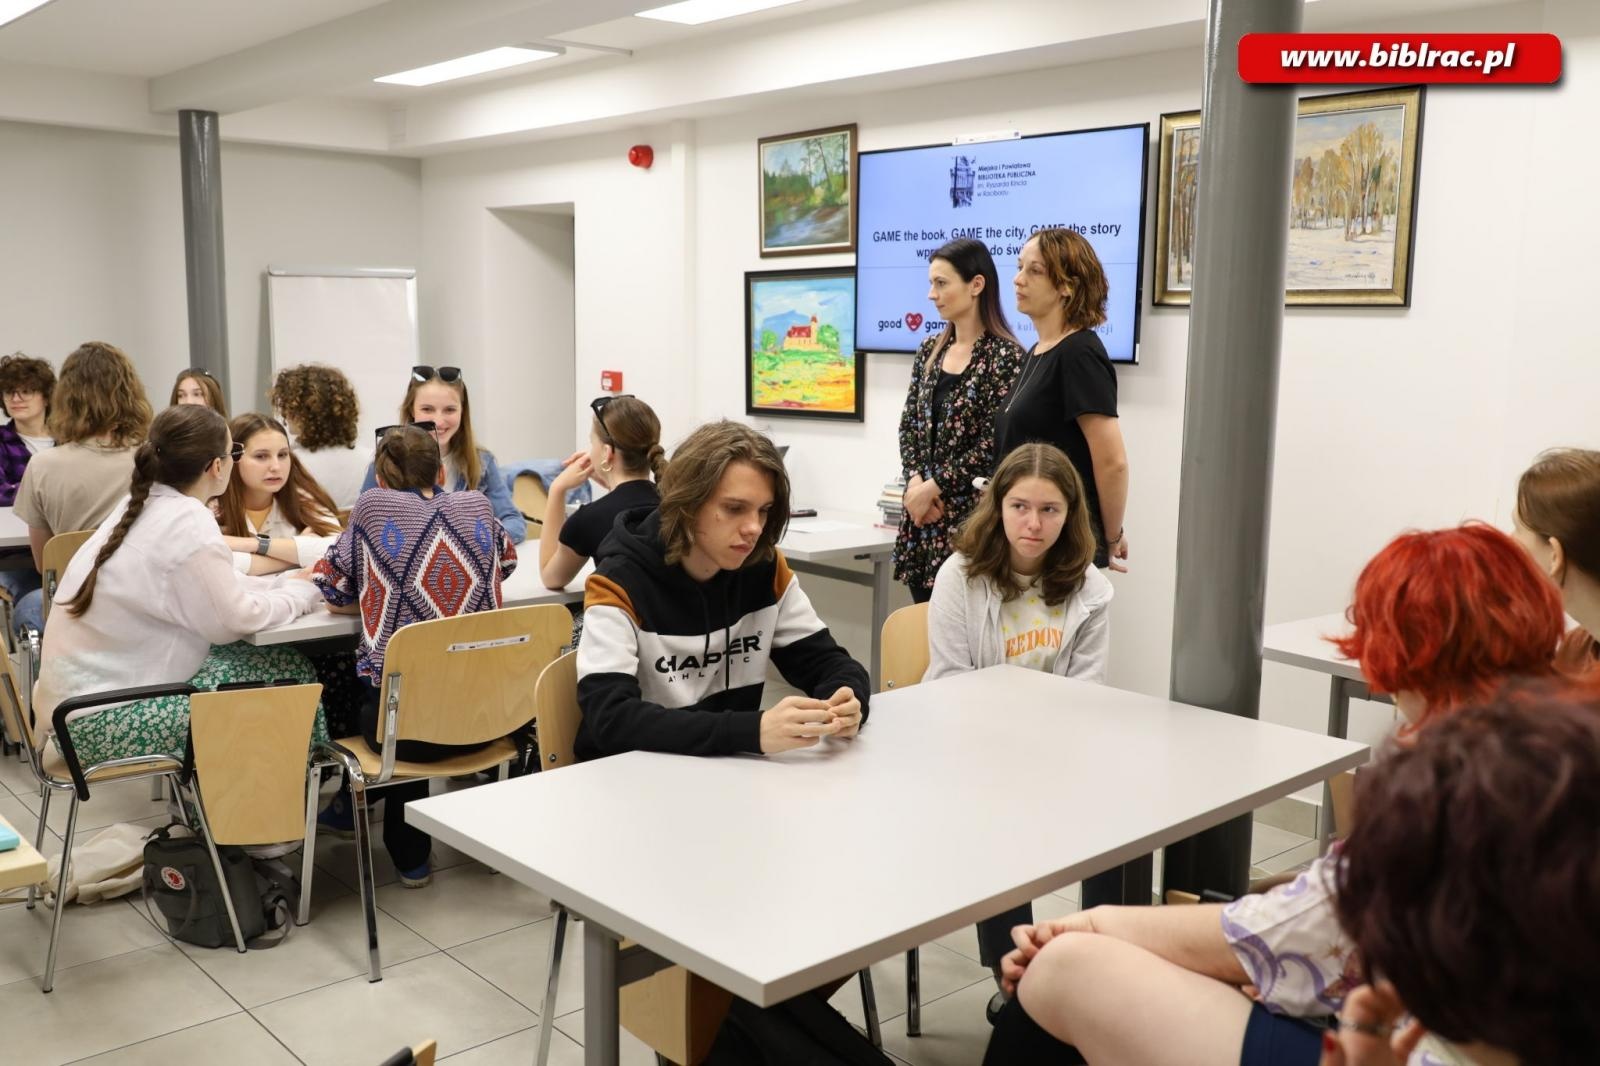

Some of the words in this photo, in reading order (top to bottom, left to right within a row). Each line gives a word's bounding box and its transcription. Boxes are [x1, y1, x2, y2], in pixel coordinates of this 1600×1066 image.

[1002, 162, 1031, 170] Powiatowa
[978, 172, 1006, 180] BIBLIOTEKA
[1007, 170, 1036, 178] PUBLICZNA
[873, 230, 901, 242] GAME
[904, 231, 918, 241] the
[921, 229, 948, 241] book,
[951, 227, 982, 239] GAME
[986, 226, 1002, 238] the
[1005, 225, 1027, 240] city,
[1090, 223, 1122, 237] story
[990, 244, 1003, 256] do
[878, 319, 902, 332] good
[925, 320, 948, 333] gam
